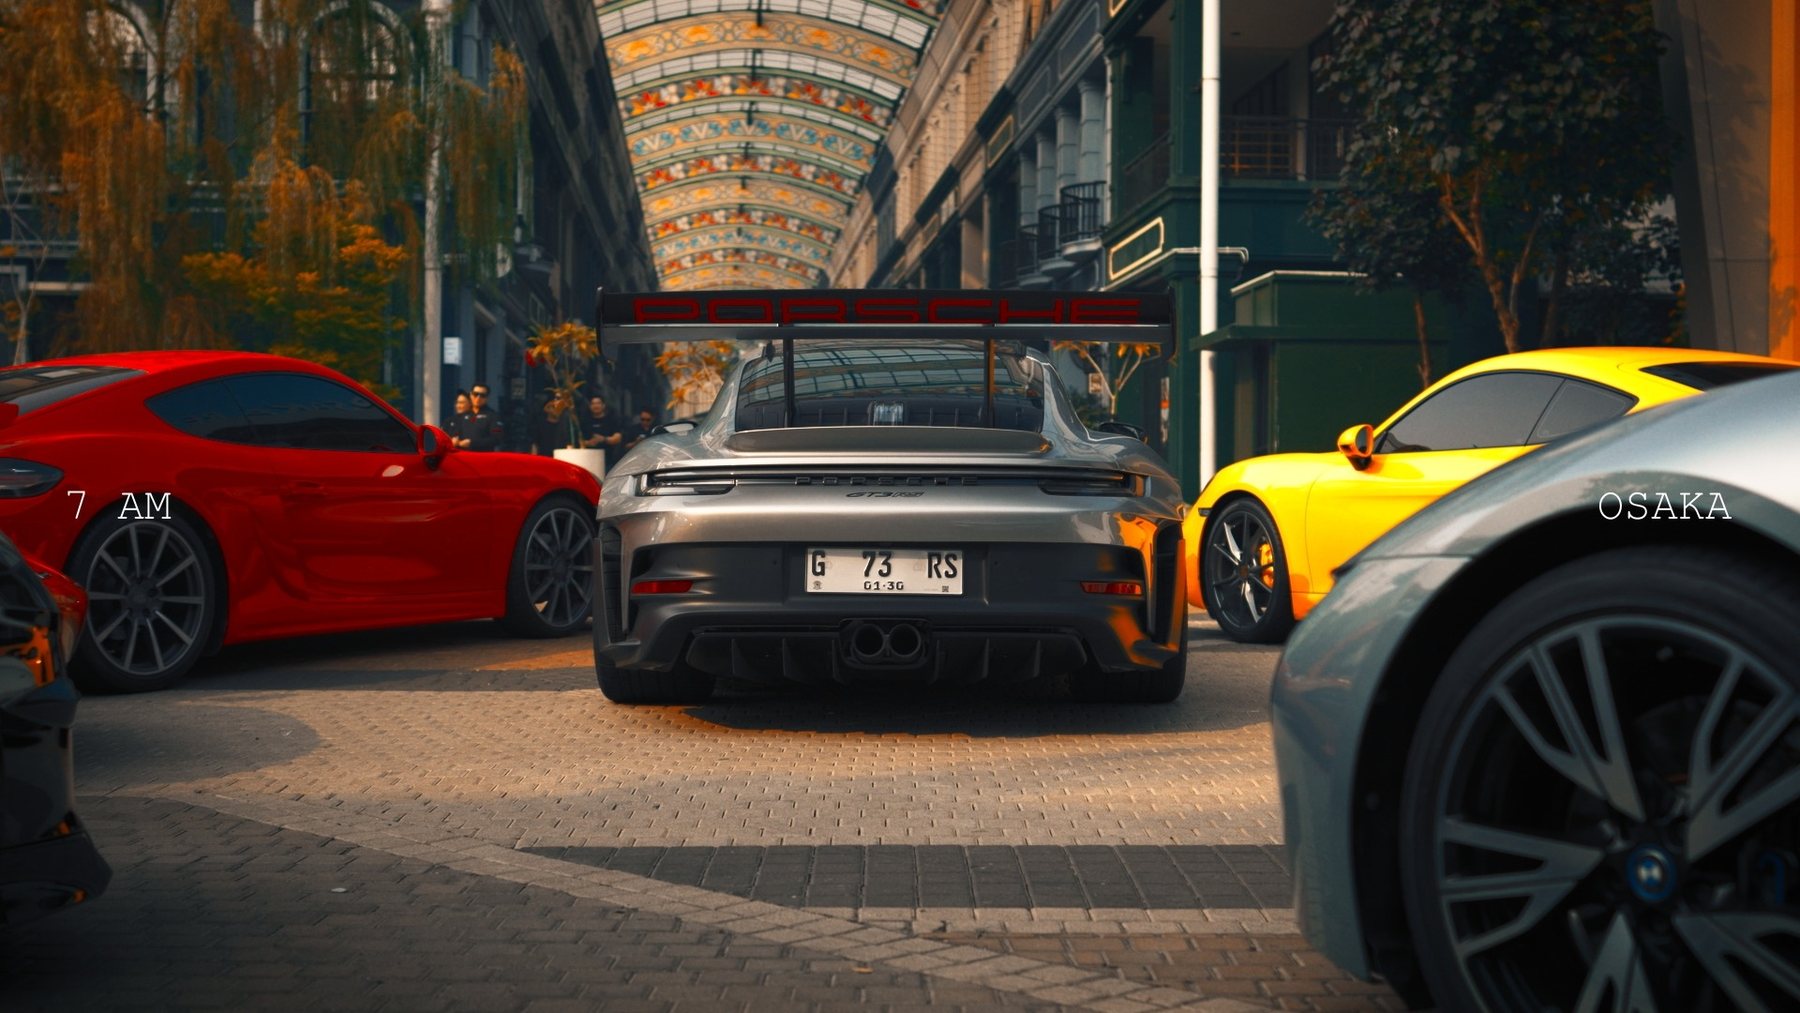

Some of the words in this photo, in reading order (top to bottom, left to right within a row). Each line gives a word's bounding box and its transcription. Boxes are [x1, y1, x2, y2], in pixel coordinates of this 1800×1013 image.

[634, 298, 1140, 325] PORSCHE
[811, 550, 826, 576] G
[862, 551, 892, 577] 73
[927, 552, 958, 579] RS
